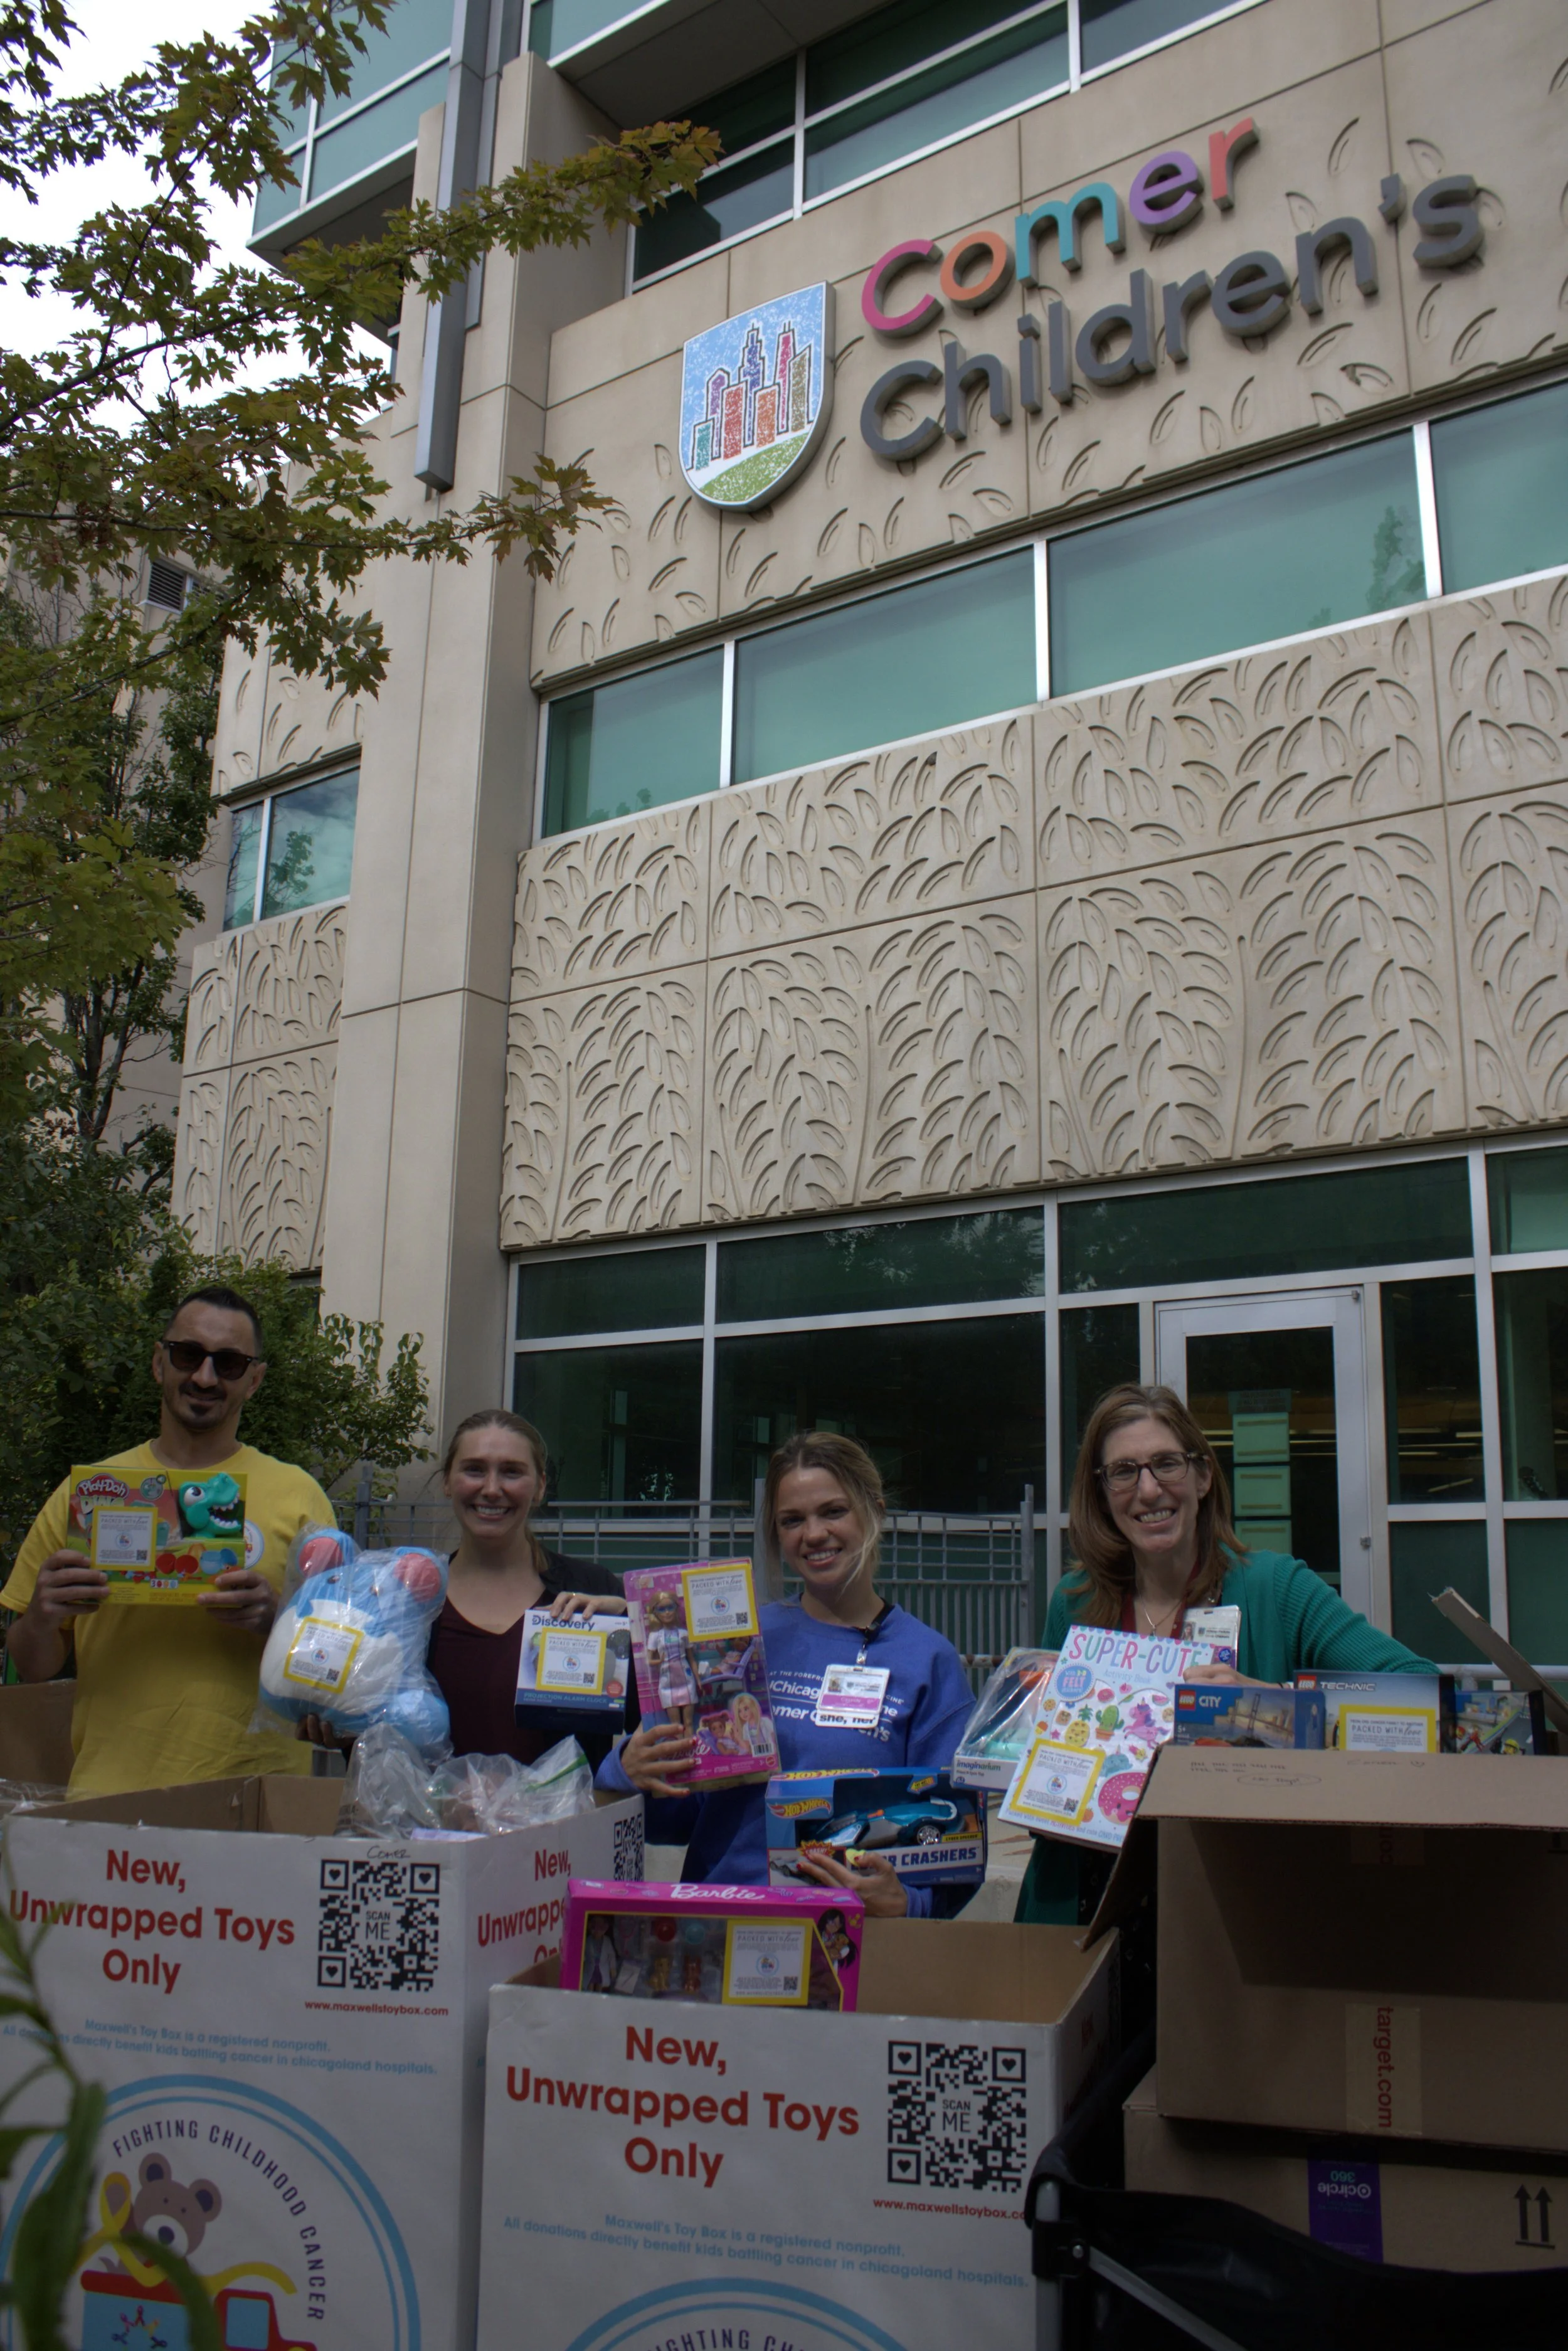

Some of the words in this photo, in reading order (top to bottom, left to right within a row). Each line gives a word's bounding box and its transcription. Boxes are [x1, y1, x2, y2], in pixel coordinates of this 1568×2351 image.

[861, 117, 1258, 337] Comer
[860, 174, 1481, 463] Children's
[532, 1615, 595, 1632] Discovery
[1179, 1695, 1195, 1705] LEGO
[1199, 1696, 1222, 1708] CITY
[1298, 1679, 1316, 1689] LEGO
[1320, 1682, 1376, 1692] TECHNIC
[1352, 1725, 1382, 1734] PACKED
[1385, 1727, 1404, 1735] WITH
[956, 1760, 1001, 1771] imaginarium
[784, 1802, 801, 1817] HOT
[800, 1799, 829, 1812] WHEELS
[106, 1850, 186, 1892] New,
[535, 1849, 571, 1881] New,
[901, 1847, 977, 1866] CRASHERS
[669, 1883, 766, 1901] Barbie
[9, 1889, 202, 1941] Unwrapped
[214, 1908, 295, 1950] Toys
[365, 1923, 390, 1941] ME
[366, 1911, 391, 1921] SCAN
[102, 1949, 181, 1994] Only
[305, 2001, 449, 2016] www.maxwellstoybox.com
[85, 2019, 137, 2035] Maxwell's
[139, 2024, 158, 2038] Toy
[161, 2027, 182, 2040] Box
[185, 2029, 194, 2041] is
[196, 2032, 206, 2042] a
[208, 2032, 270, 2050] registered
[272, 2036, 331, 2053] nonprofit.
[625, 2026, 728, 2076] New,
[72, 2032, 113, 2050] directly
[115, 2038, 153, 2053] benefit
[156, 2042, 179, 2056] kids
[181, 2045, 229, 2063] battling
[231, 2051, 273, 2065] cancer
[276, 2053, 289, 2065] in
[292, 2054, 371, 2073] chicagoland
[374, 2056, 438, 2076] hospitals.
[1374, 2007, 1394, 2127] target.com
[506, 2066, 750, 2128] Unwrapped
[763, 2093, 860, 2141] Toys
[942, 2099, 972, 2111] SCAN
[113, 2120, 199, 2157] FIGHTING
[942, 2111, 971, 2133] ME
[208, 2124, 307, 2217] CHILDHOOD
[624, 2136, 724, 2188] Only
[1330, 2170, 1356, 2183] 360
[1317, 2182, 1357, 2199] circle
[503, 2216, 522, 2229] All
[524, 2219, 587, 2238] donations
[590, 2227, 639, 2251] directly
[643, 2233, 692, 2253] benefit
[694, 2239, 724, 2257] kids
[727, 2242, 783, 2266] battling
[786, 2251, 837, 2269] cancer
[841, 2256, 855, 2271] in
[859, 2258, 953, 2281] chicagoland
[956, 2266, 1029, 2288] hospitals.
[605, 2214, 671, 2235] Maxwell's
[675, 2221, 698, 2239] Toy
[701, 2224, 727, 2239] Box
[731, 2227, 743, 2241] is
[746, 2231, 756, 2242] a
[760, 2229, 832, 2253] registered
[835, 2237, 904, 2258] nonprofit.
[300, 2225, 327, 2320] CANCER
